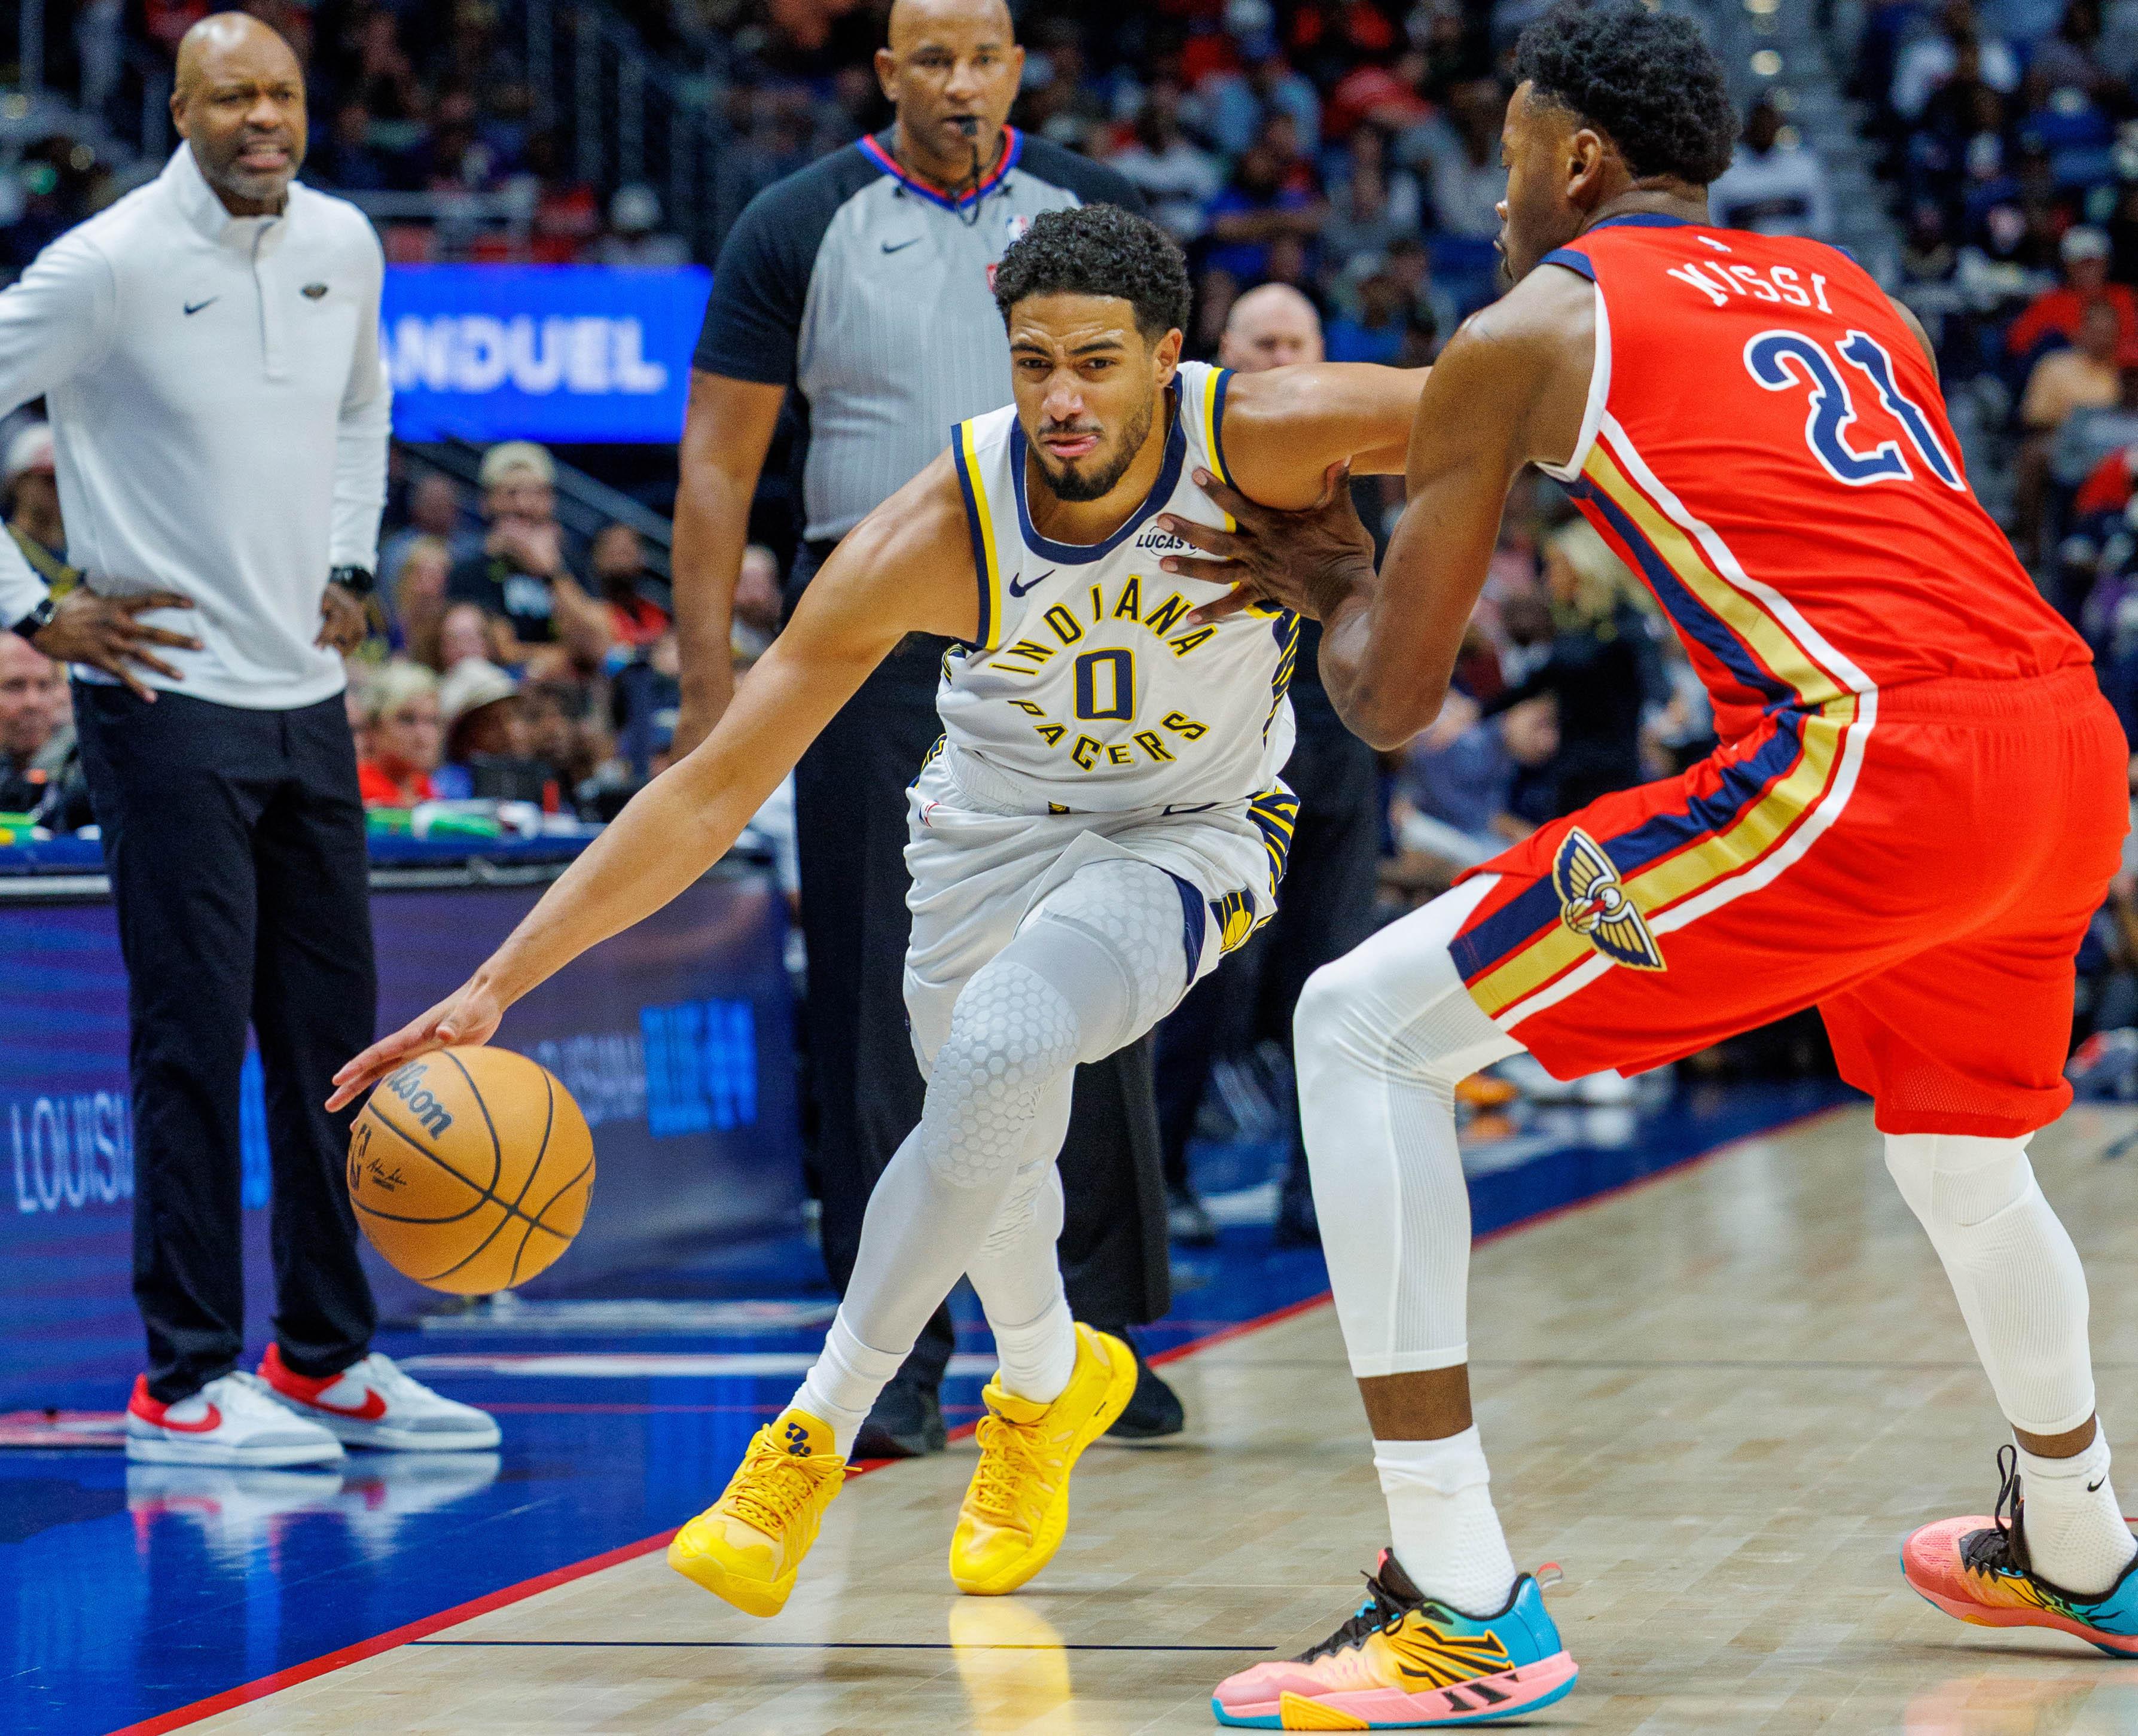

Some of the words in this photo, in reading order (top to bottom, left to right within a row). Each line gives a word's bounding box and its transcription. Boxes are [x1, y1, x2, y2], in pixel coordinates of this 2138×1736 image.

[382, 313, 669, 396] NDUEL
[1743, 329, 1967, 492] 21
[1135, 534, 1184, 549] LUCAS
[988, 574, 1219, 676] INDIANA
[1073, 646, 1137, 723] 0
[1007, 700, 1210, 771] PACERS
[387, 1060, 453, 1140] ilson
